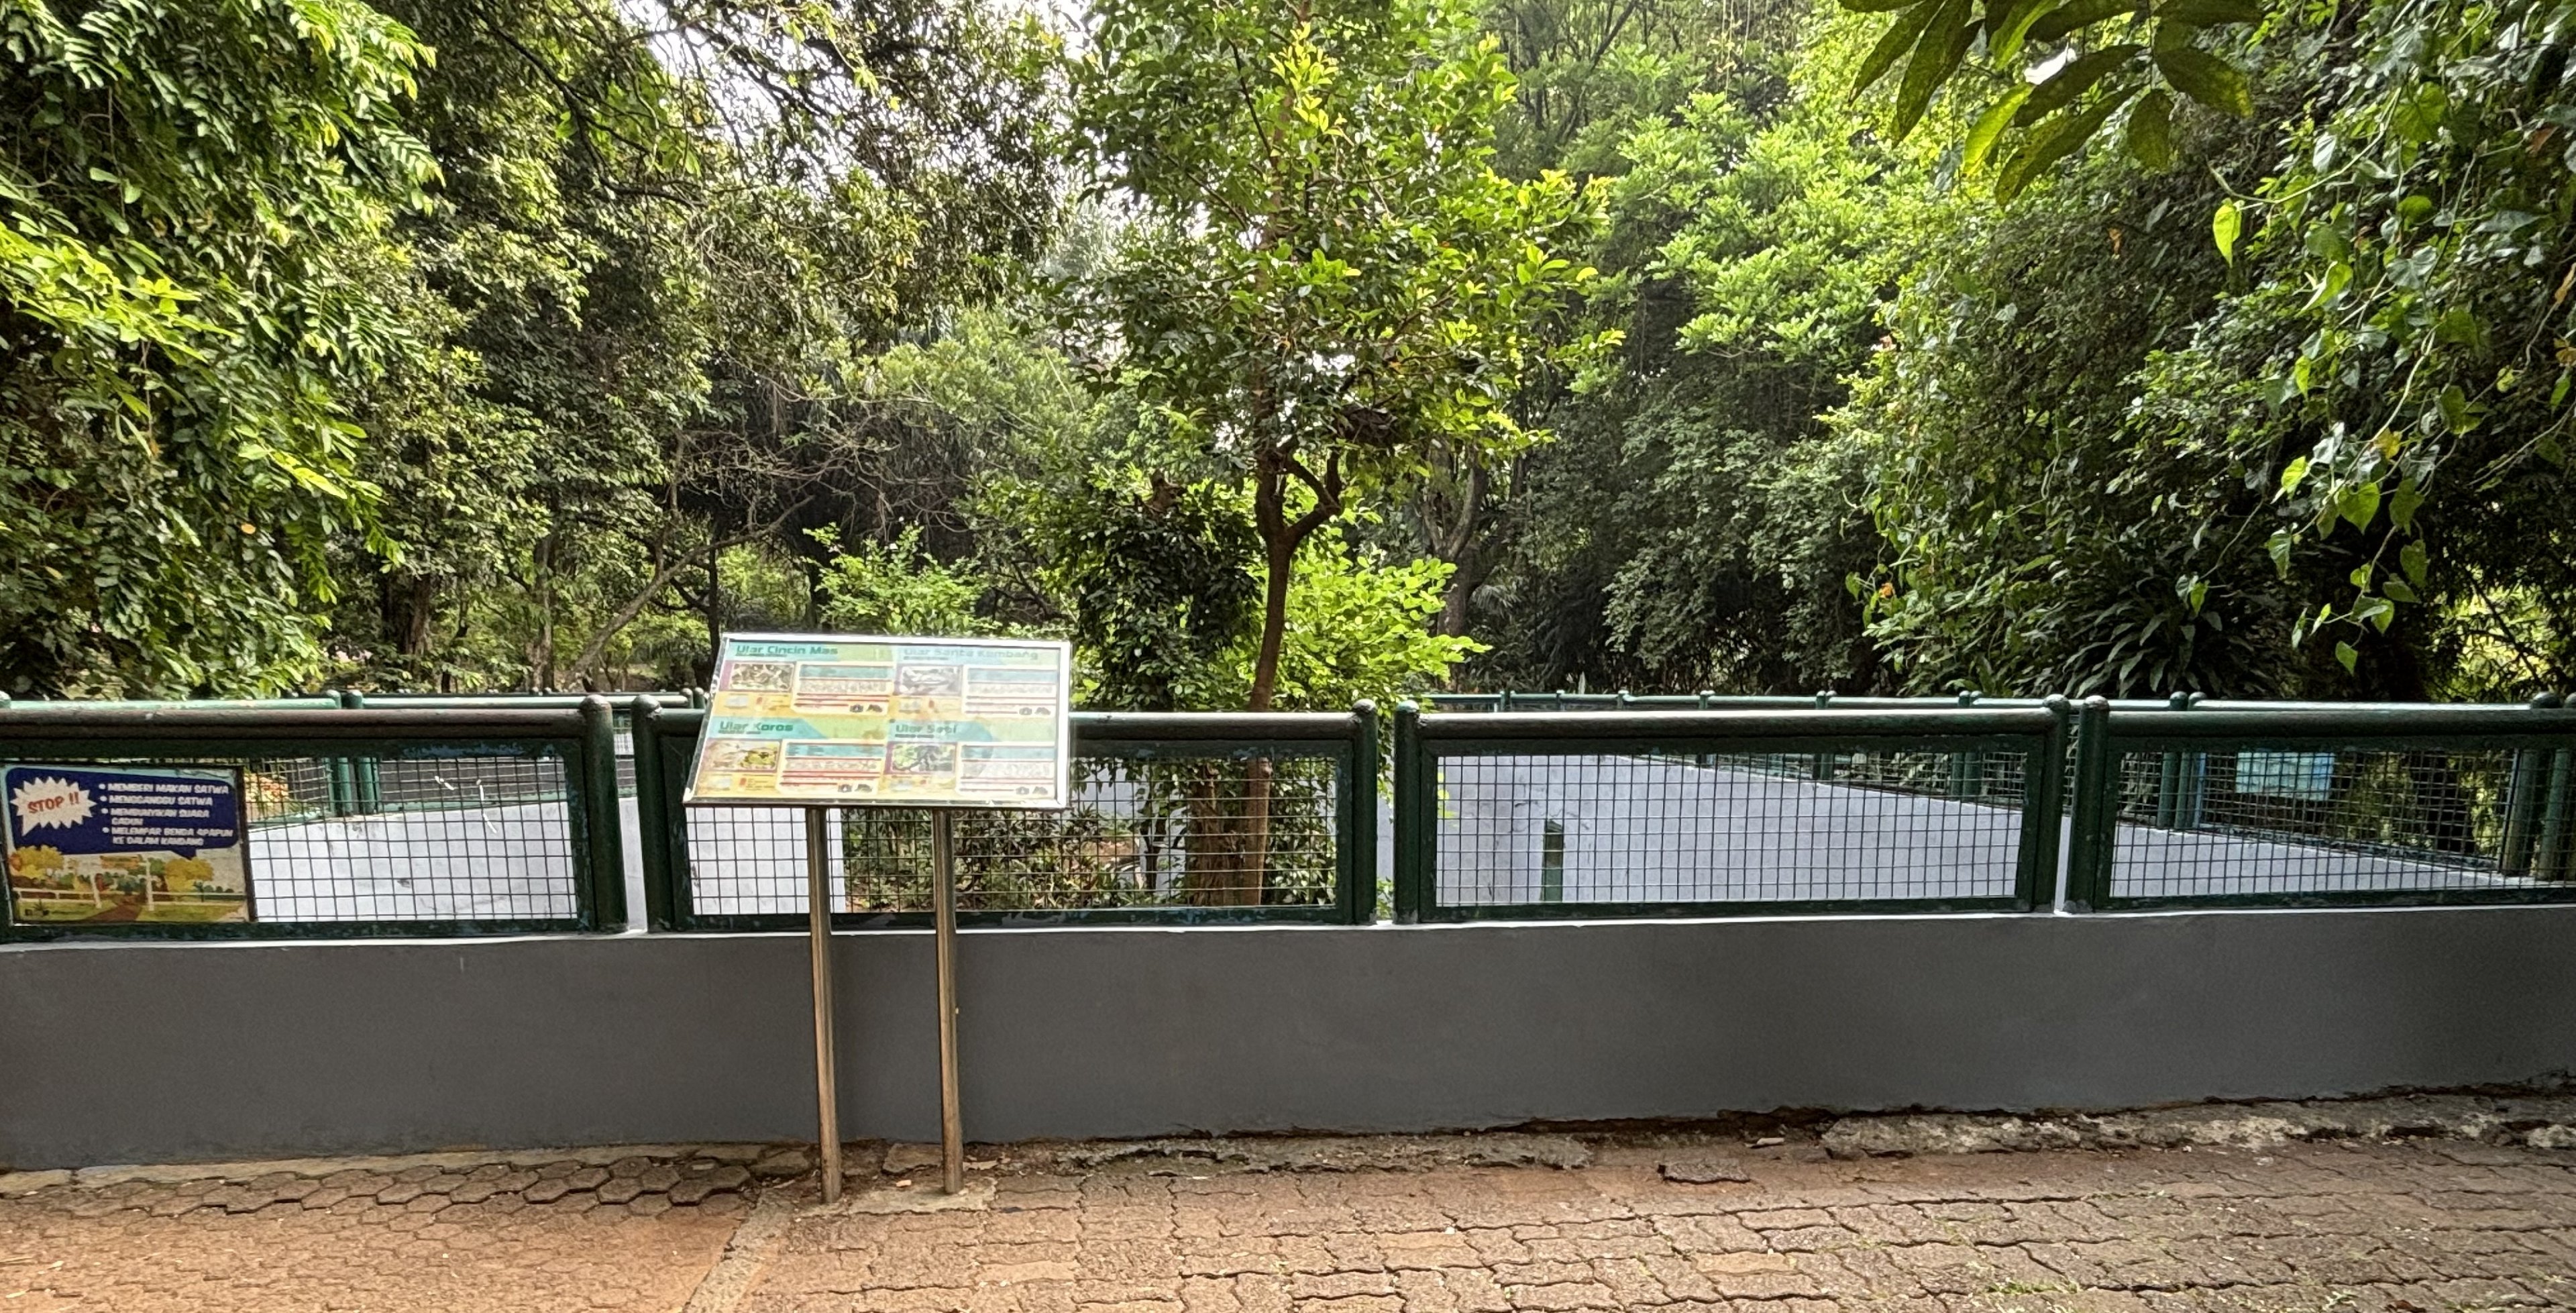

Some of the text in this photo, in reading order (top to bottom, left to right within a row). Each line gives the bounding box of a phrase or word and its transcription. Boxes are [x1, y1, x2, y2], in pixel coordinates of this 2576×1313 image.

[737, 645, 838, 655] Ular Cincin Mas
[720, 721, 794, 731] Ular Koros
[107, 782, 229, 794] MEMBERI MAKAN SATWA
[28, 791, 79, 814] STOP !!
[109, 795, 213, 806] MENGGANGGU SATWA
[111, 827, 162, 835] MELEMPAR
